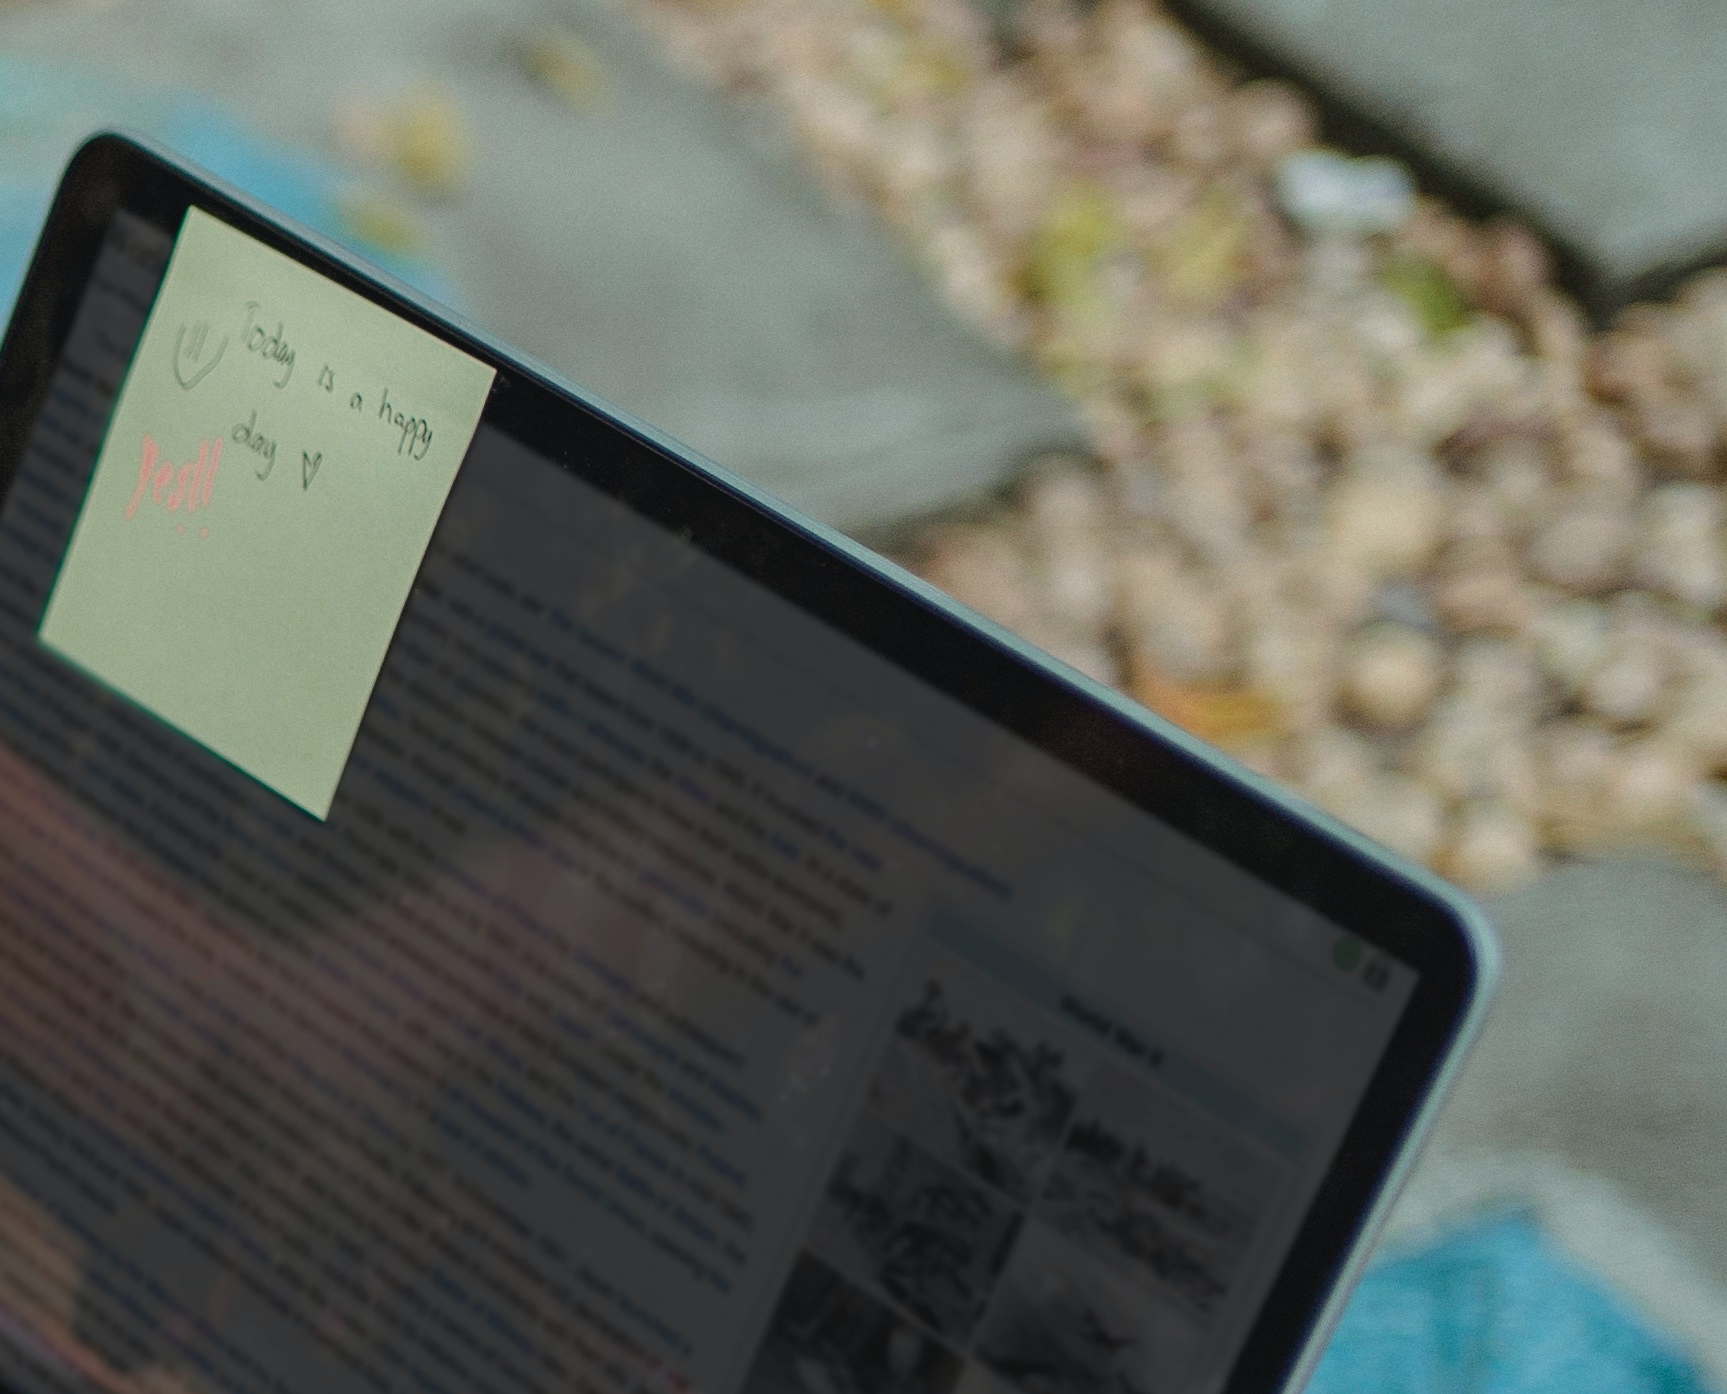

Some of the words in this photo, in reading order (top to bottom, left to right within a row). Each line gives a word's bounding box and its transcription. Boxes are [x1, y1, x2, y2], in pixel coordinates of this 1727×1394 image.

[238, 299, 297, 390] Today
[317, 362, 336, 394] is
[348, 389, 364, 413] a
[376, 387, 434, 462] happy
[230, 409, 278, 482] day
